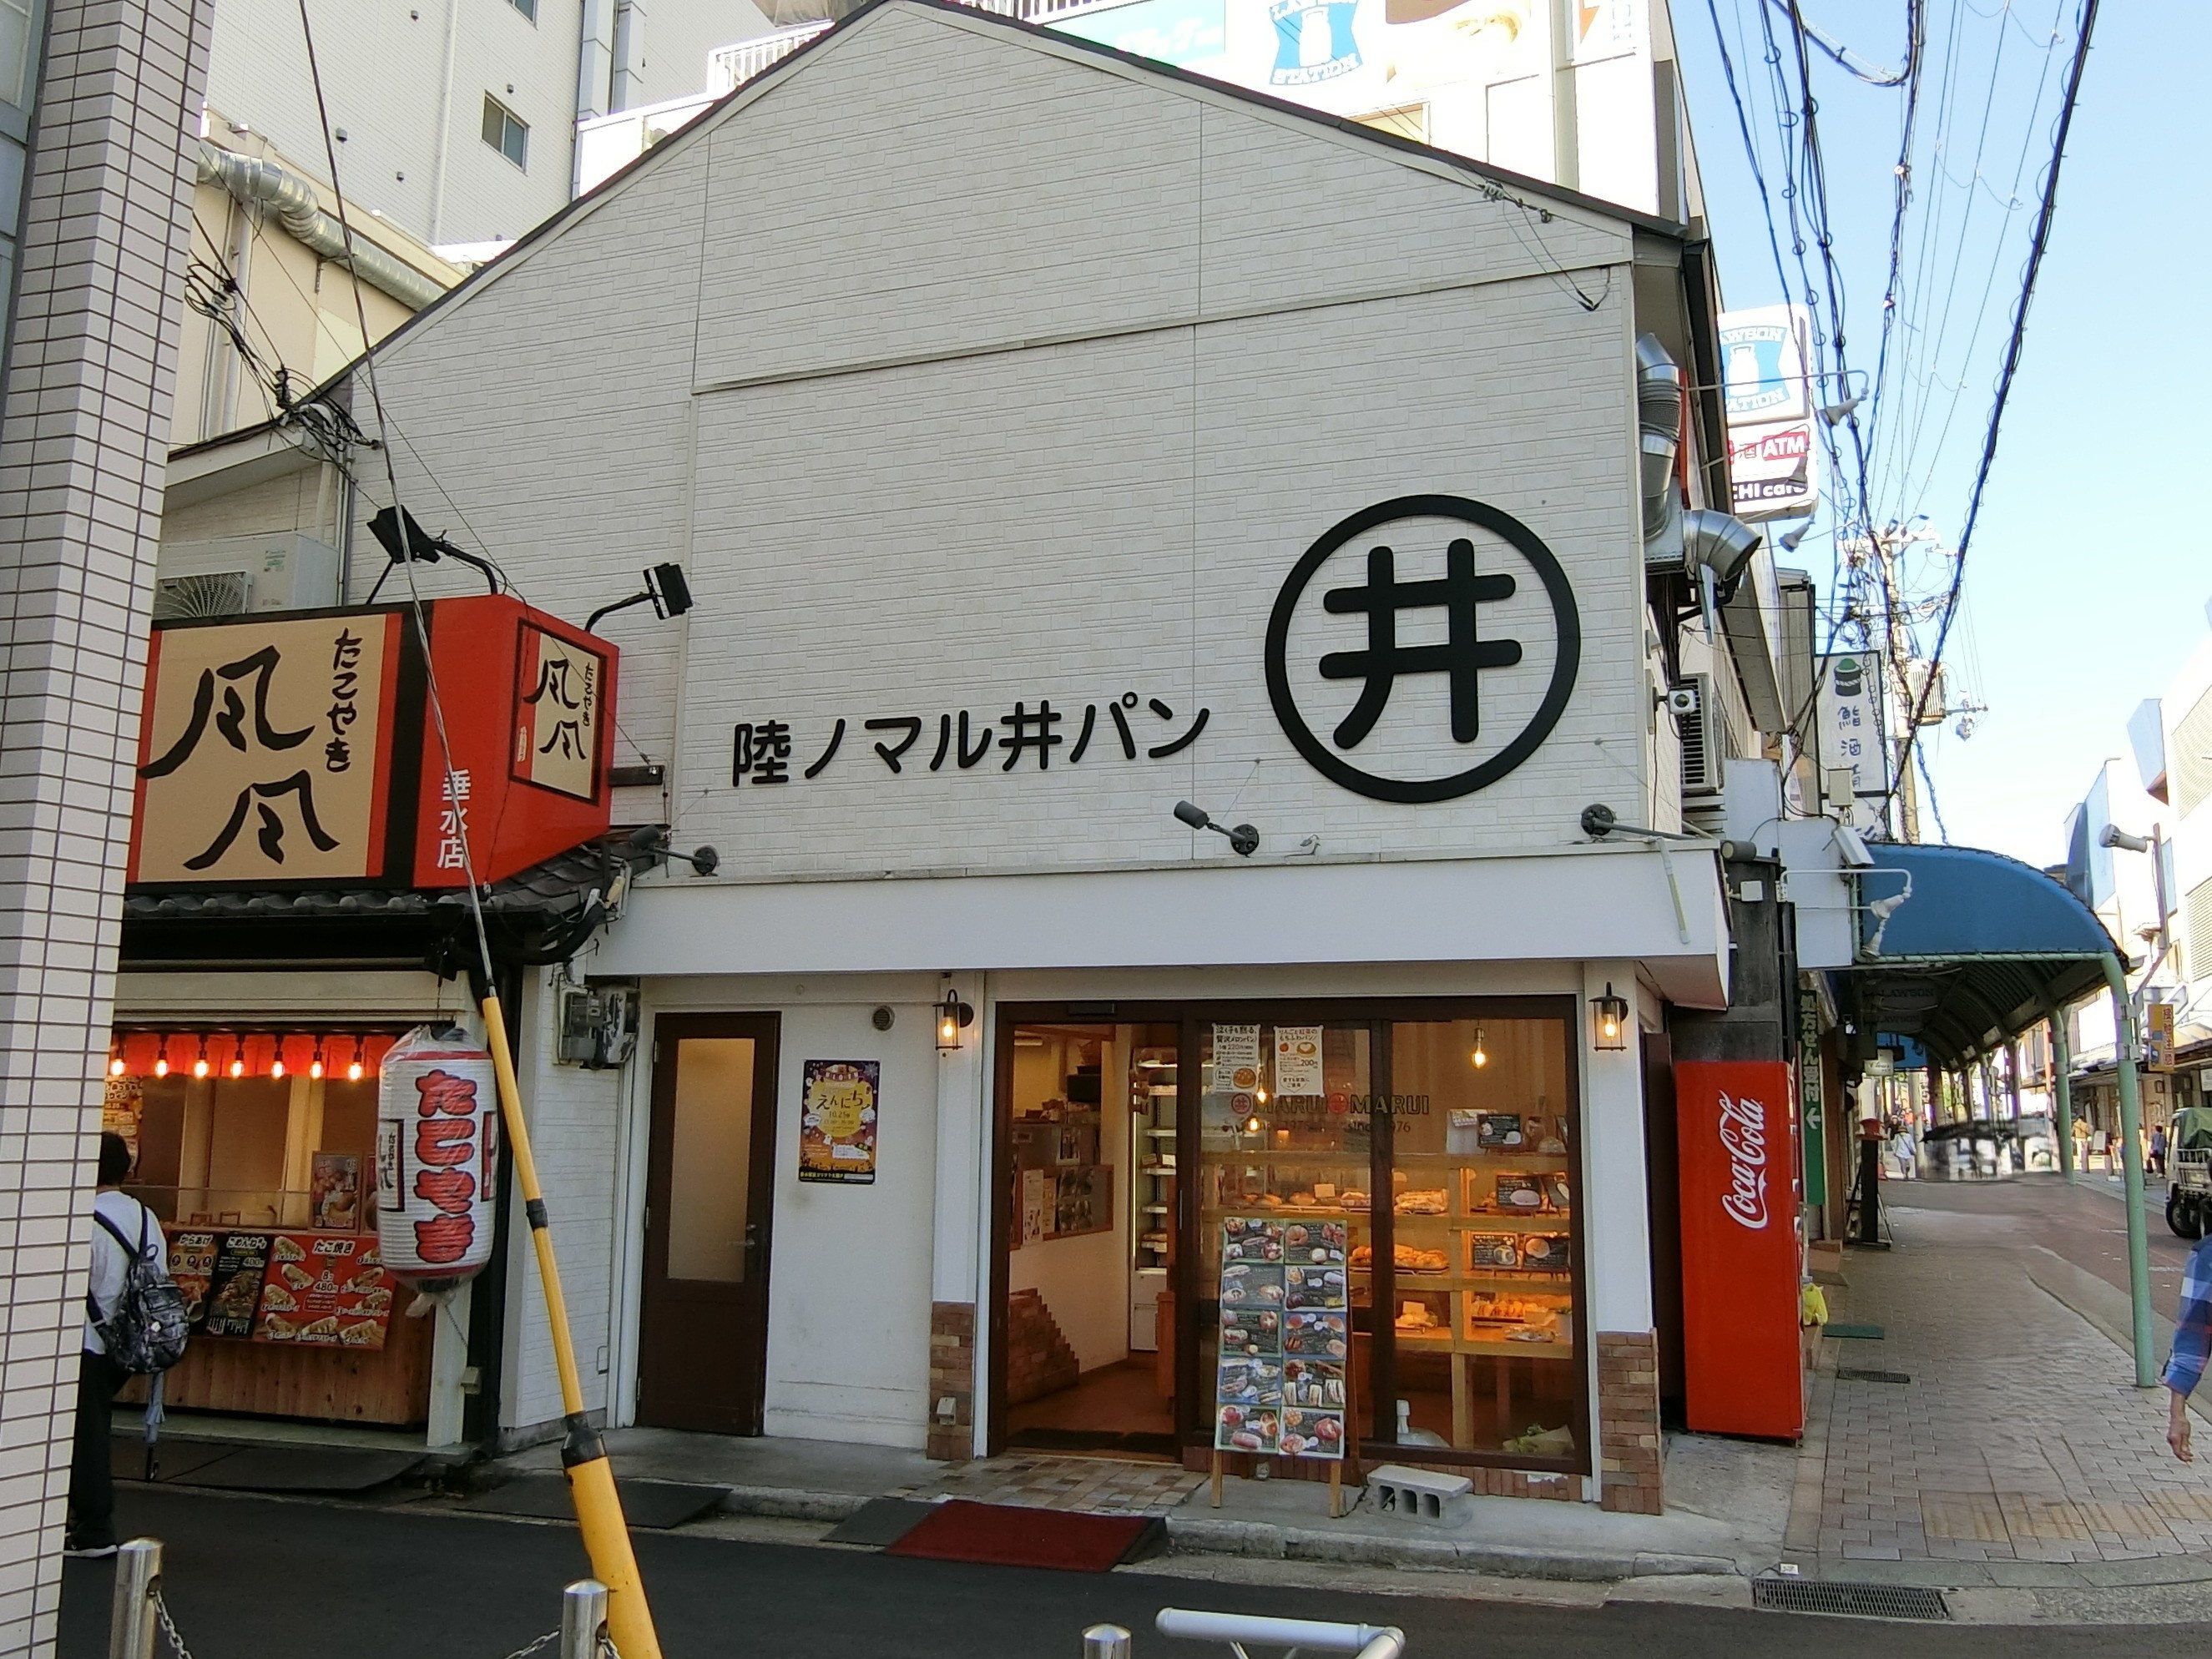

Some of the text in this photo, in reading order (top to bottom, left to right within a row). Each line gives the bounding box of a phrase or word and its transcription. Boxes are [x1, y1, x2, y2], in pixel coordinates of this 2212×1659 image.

[1763, 434, 1805, 458] ATM
[1319, 538, 1522, 749] 井
[326, 627, 363, 773] たこやき
[733, 691, 1210, 787] 陸ノマル井パン
[437, 769, 472, 870] 垂水店
[1800, 994, 1820, 1102] 処方せん受付
[1350, 1094, 1430, 1115] MARUI
[413, 1069, 478, 1263] たこやき
[1719, 1089, 1768, 1229] Coca-Cola
[313, 1238, 355, 1255] たこ焼き
